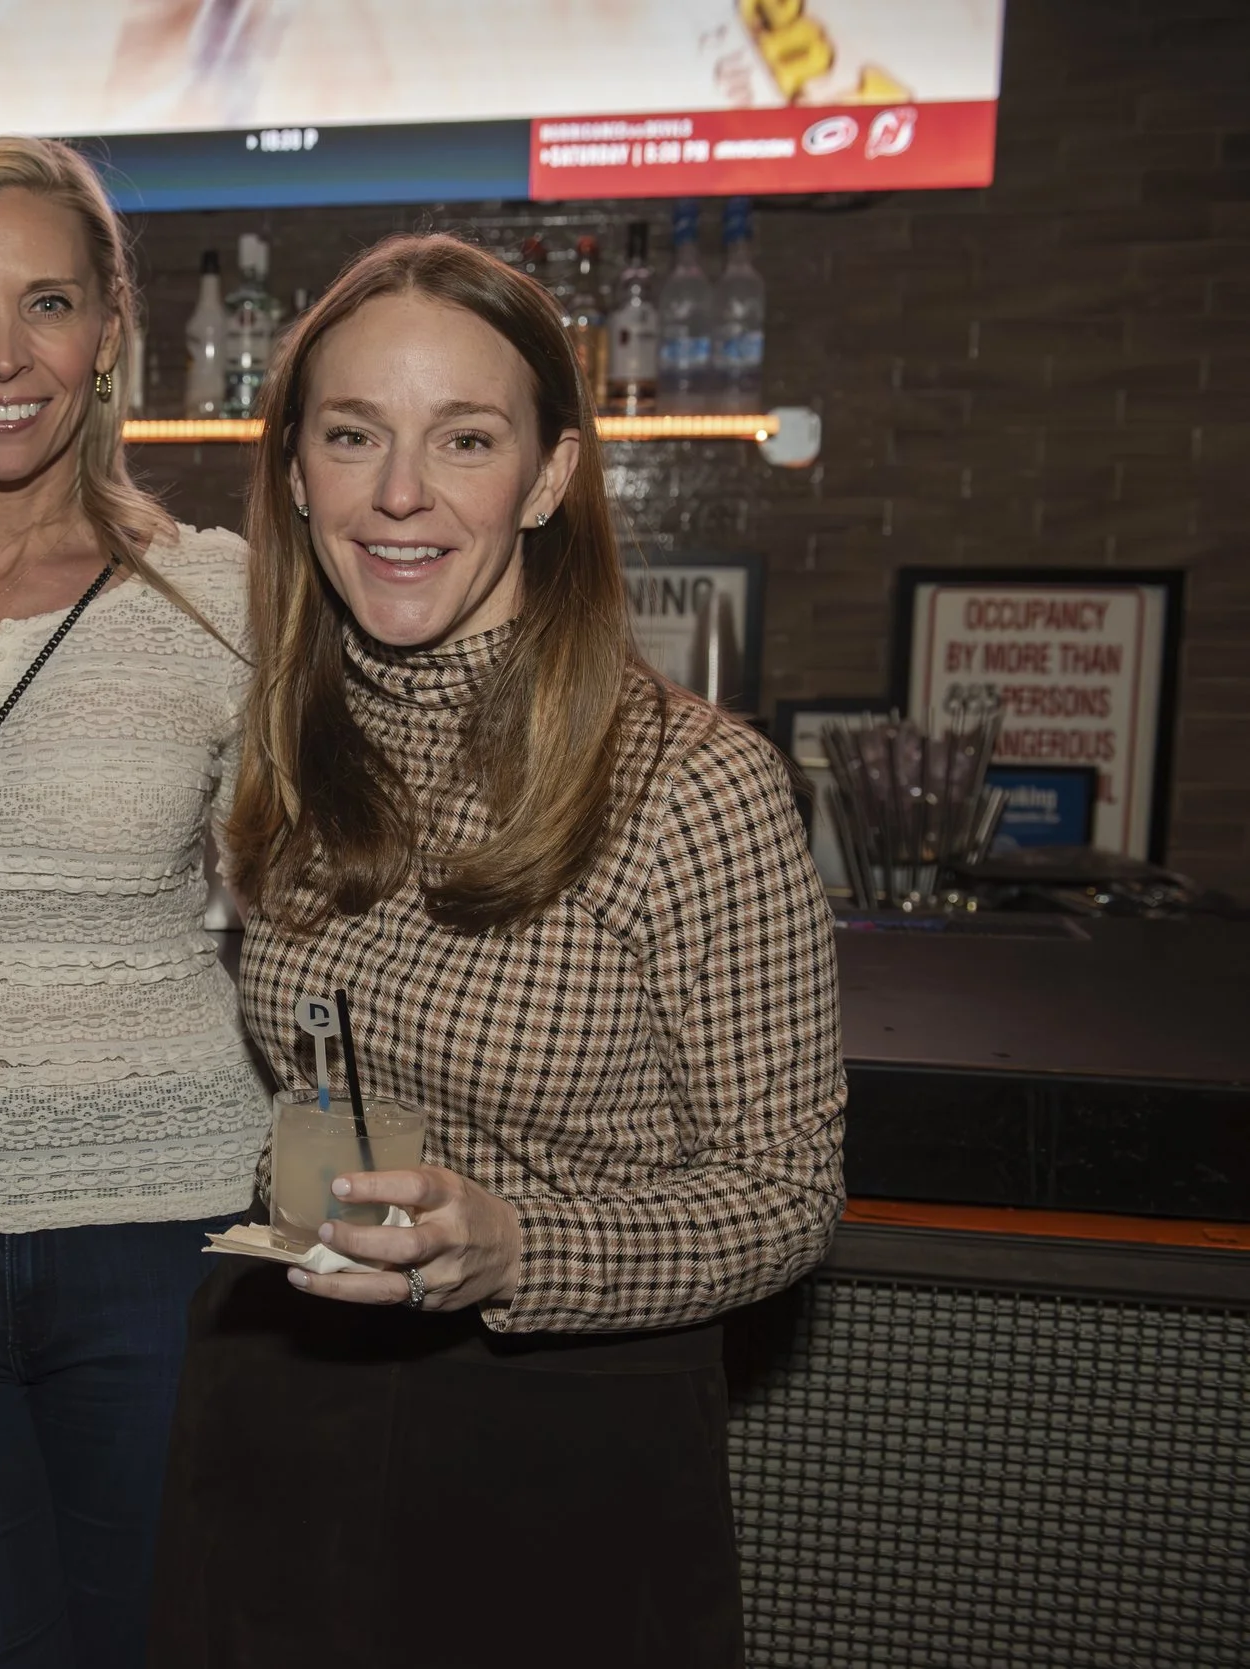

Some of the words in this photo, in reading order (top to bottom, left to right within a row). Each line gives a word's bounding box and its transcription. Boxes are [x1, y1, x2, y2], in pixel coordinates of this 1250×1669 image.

[682, 139, 710, 163] PM
[964, 598, 1110, 632] OCCUPANCY
[945, 641, 977, 675] BY
[984, 642, 1051, 675] MORE
[1059, 643, 1124, 675] THAN
[1003, 685, 1111, 718] PERSONS
[994, 729, 1116, 762] ANGEROUS
